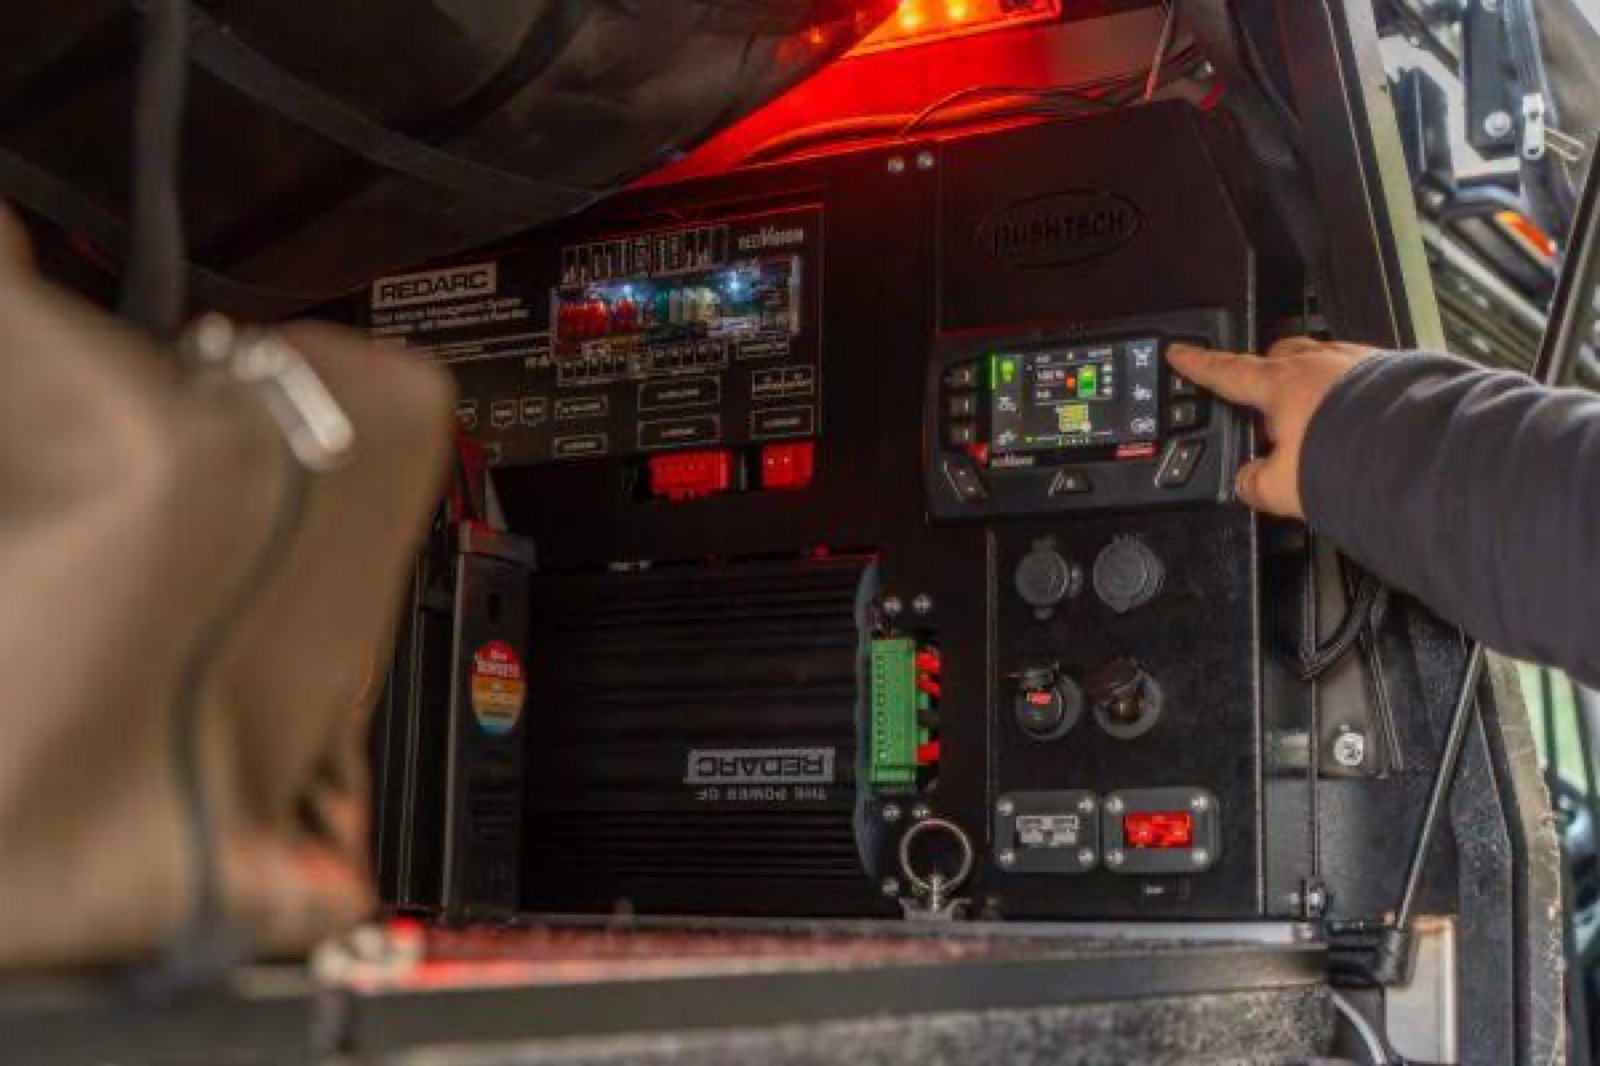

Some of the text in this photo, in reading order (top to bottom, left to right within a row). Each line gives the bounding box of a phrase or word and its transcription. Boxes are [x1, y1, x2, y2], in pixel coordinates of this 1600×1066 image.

[380, 271, 489, 303] REDARC
[696, 754, 825, 776] REDARC
[692, 785, 828, 802] THE POWER OF
